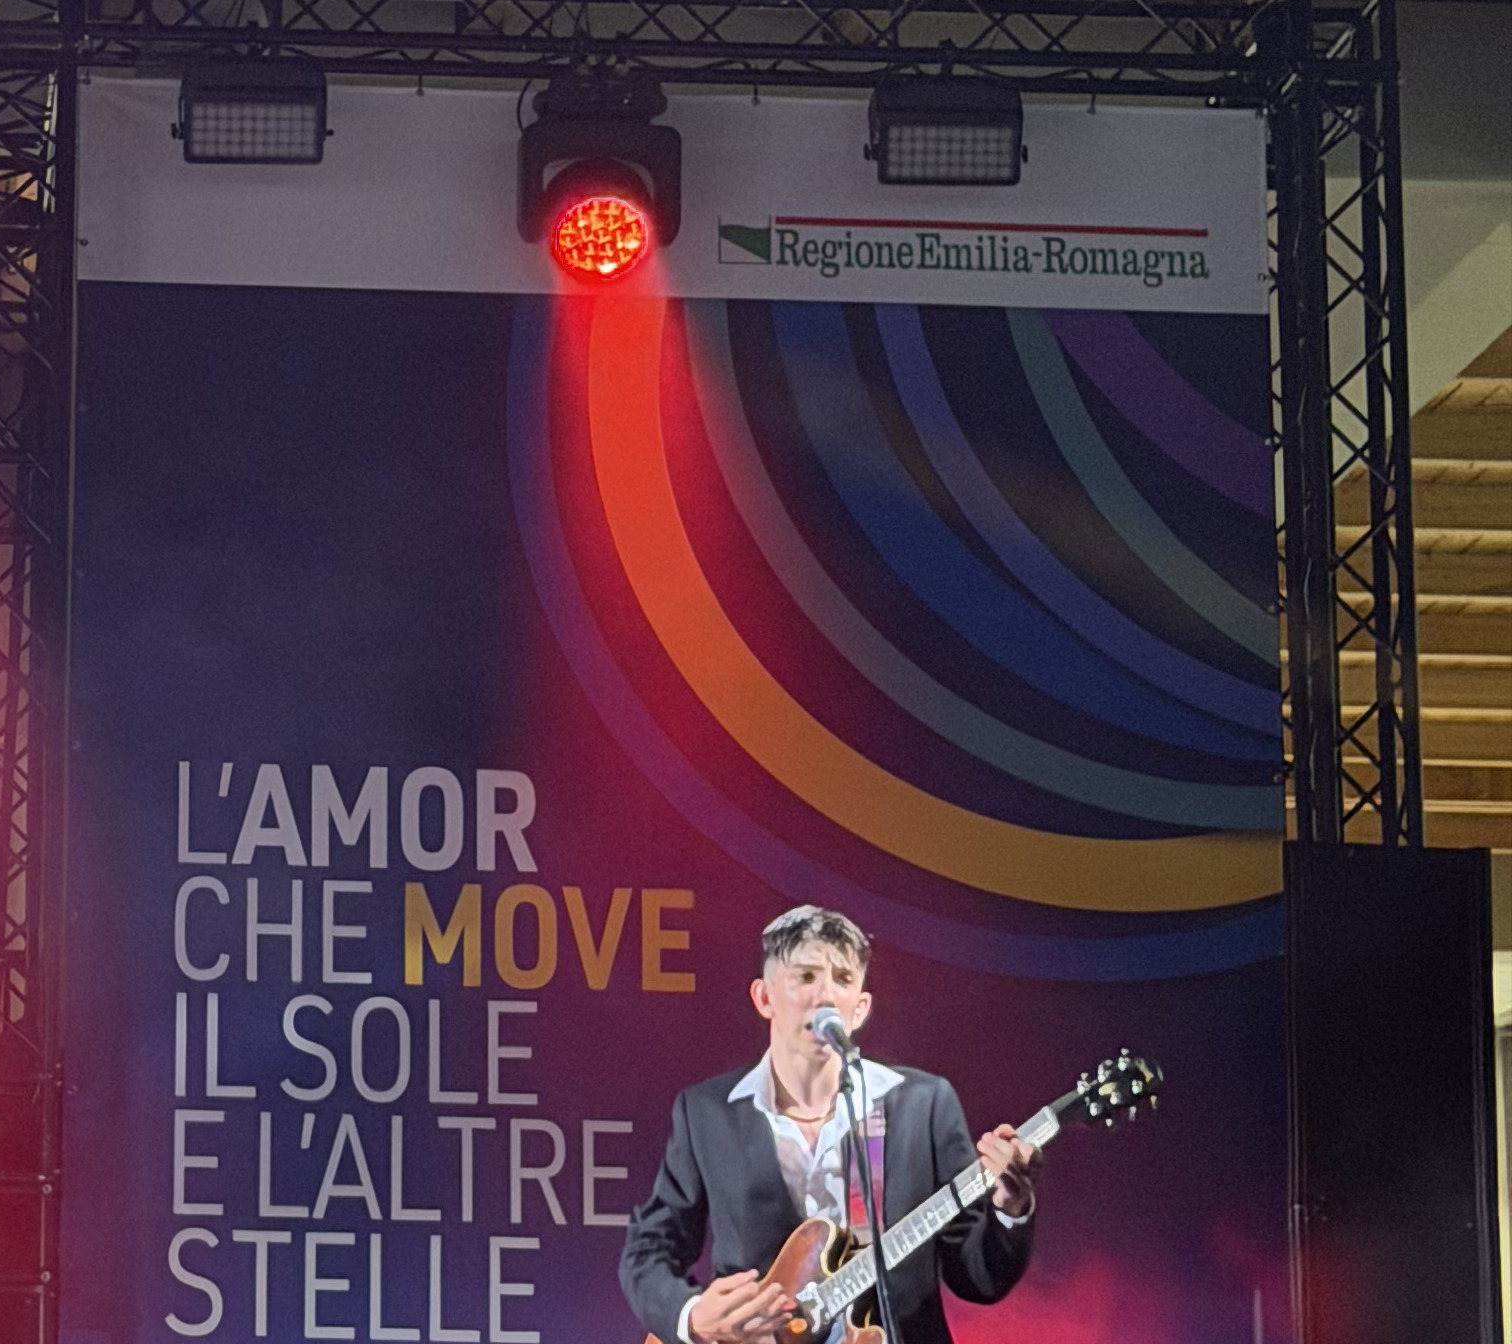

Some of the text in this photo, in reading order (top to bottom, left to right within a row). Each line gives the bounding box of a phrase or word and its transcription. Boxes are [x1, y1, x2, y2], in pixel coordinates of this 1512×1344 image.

[177, 760, 539, 872] L'AMOR
[174, 875, 697, 993] CHE MOVE
[174, 992, 539, 1105] IL SOLE
[173, 1109, 634, 1226] E L'ALTRE
[164, 1227, 542, 1344] STELLE
